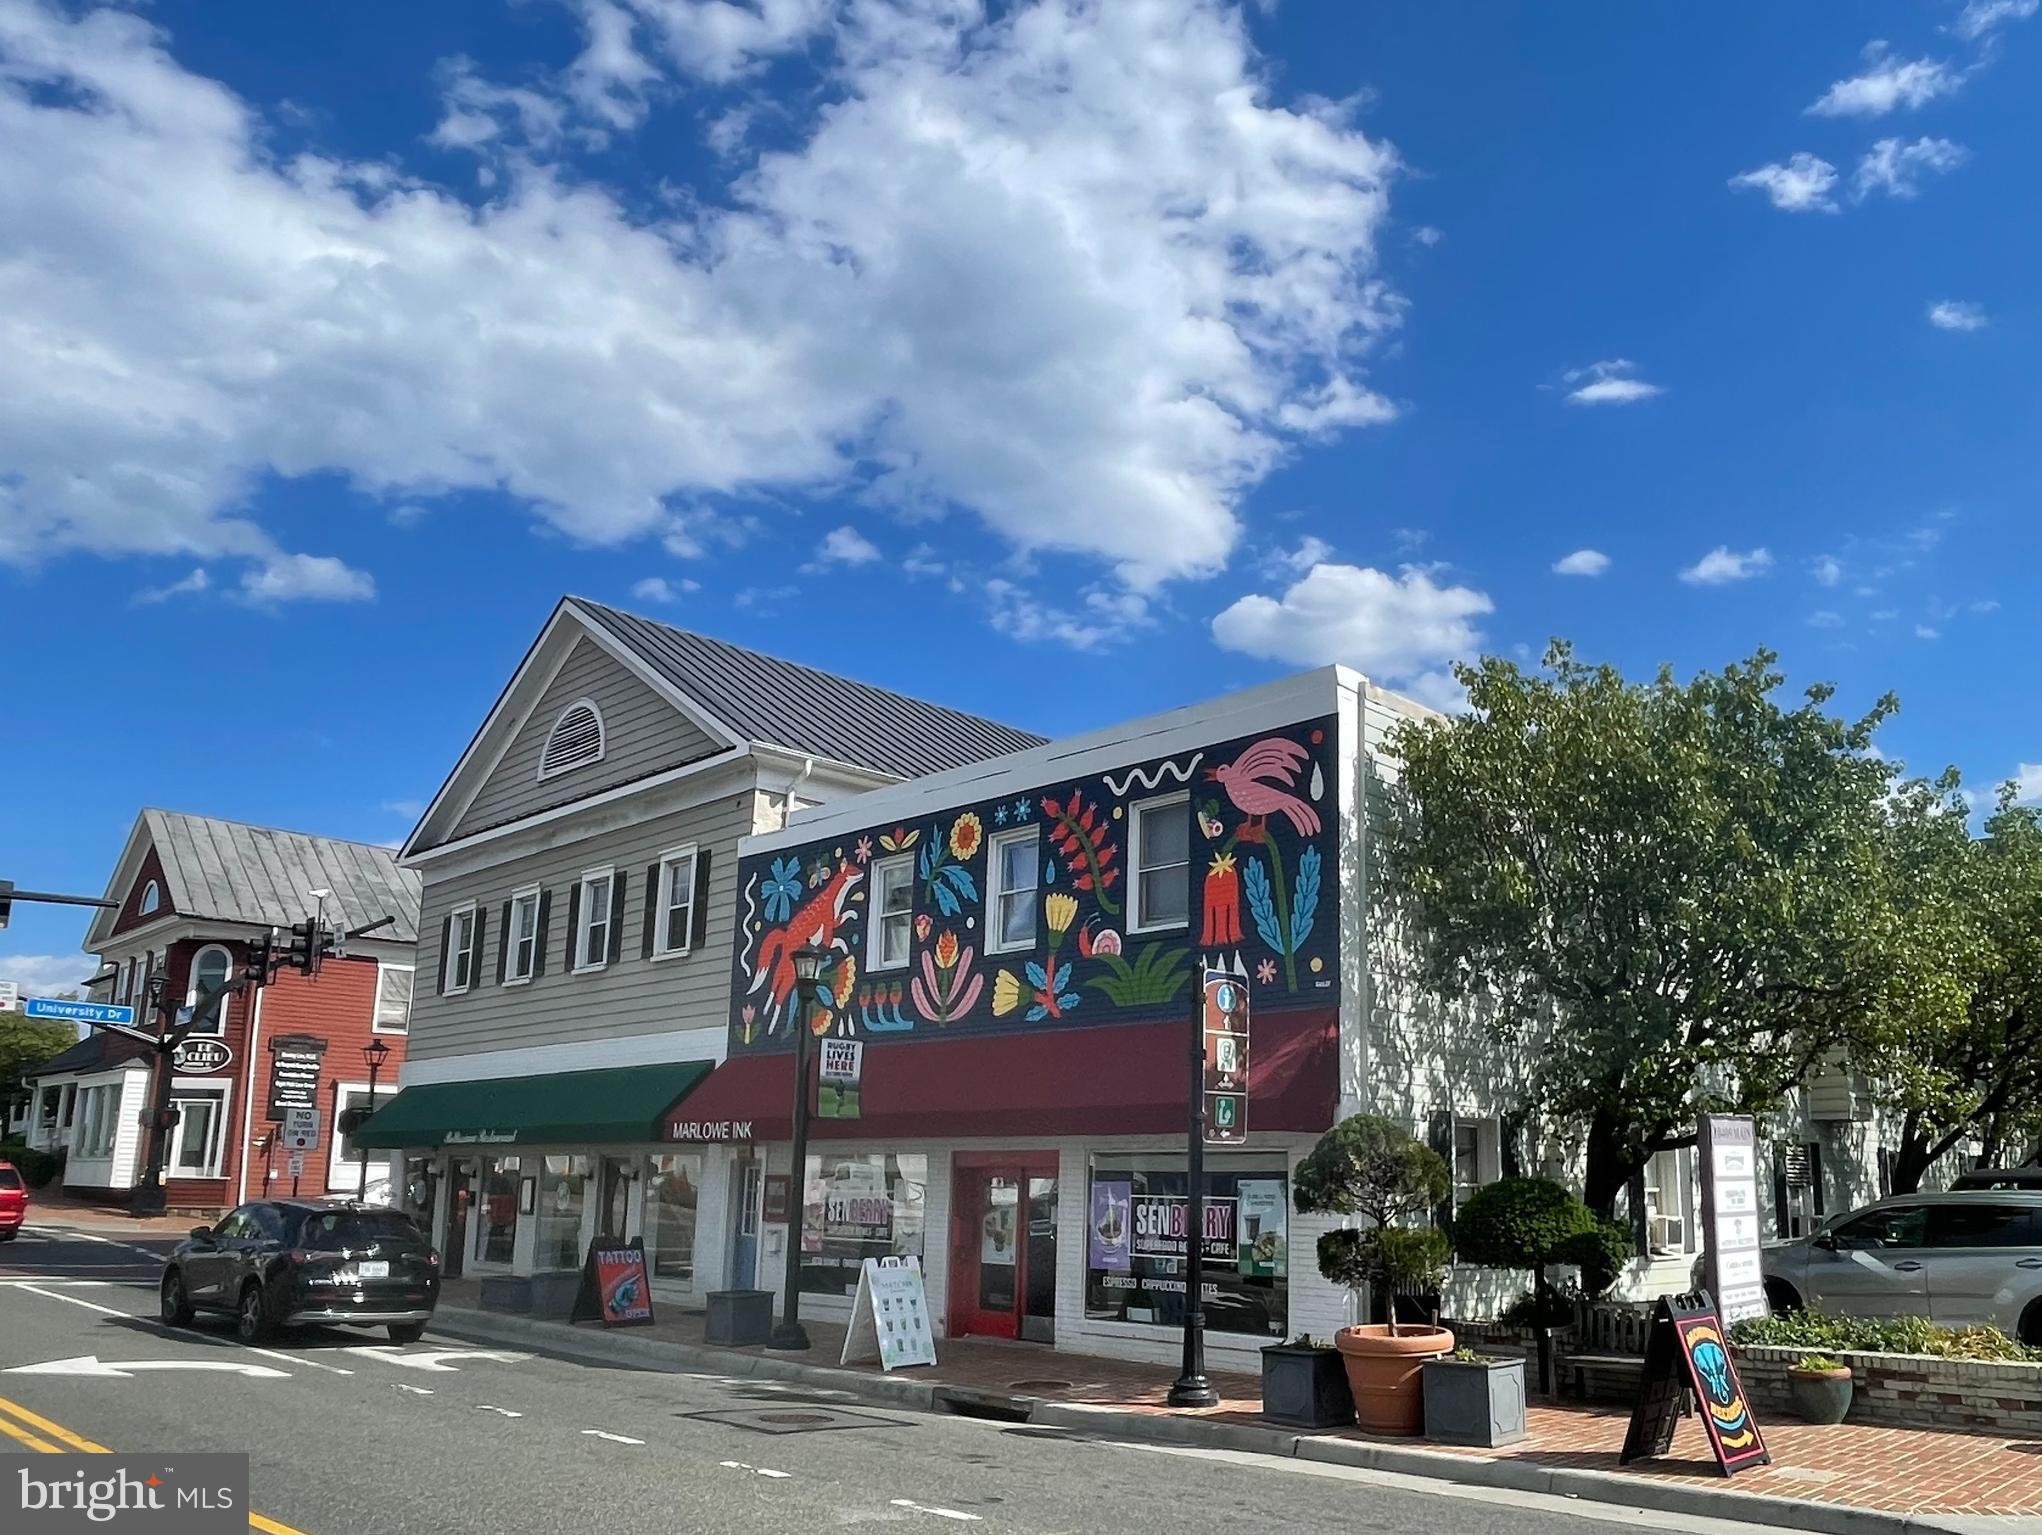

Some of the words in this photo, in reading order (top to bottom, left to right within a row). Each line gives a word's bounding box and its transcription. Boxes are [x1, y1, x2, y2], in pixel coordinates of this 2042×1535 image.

[36, 1002, 103, 1019] University
[107, 1009, 122, 1019] Dr
[827, 1042, 856, 1050] RUGBY
[827, 1050, 855, 1060] LIVES
[826, 1060, 855, 1071] HERE
[295, 1111, 312, 1120] NO
[672, 1122, 730, 1139] MARLOWE
[732, 1121, 752, 1138] INK
[1136, 1203, 1232, 1239] SENBRY
[1210, 1242, 1230, 1256] CAFE
[597, 1250, 641, 1265] TATTOO
